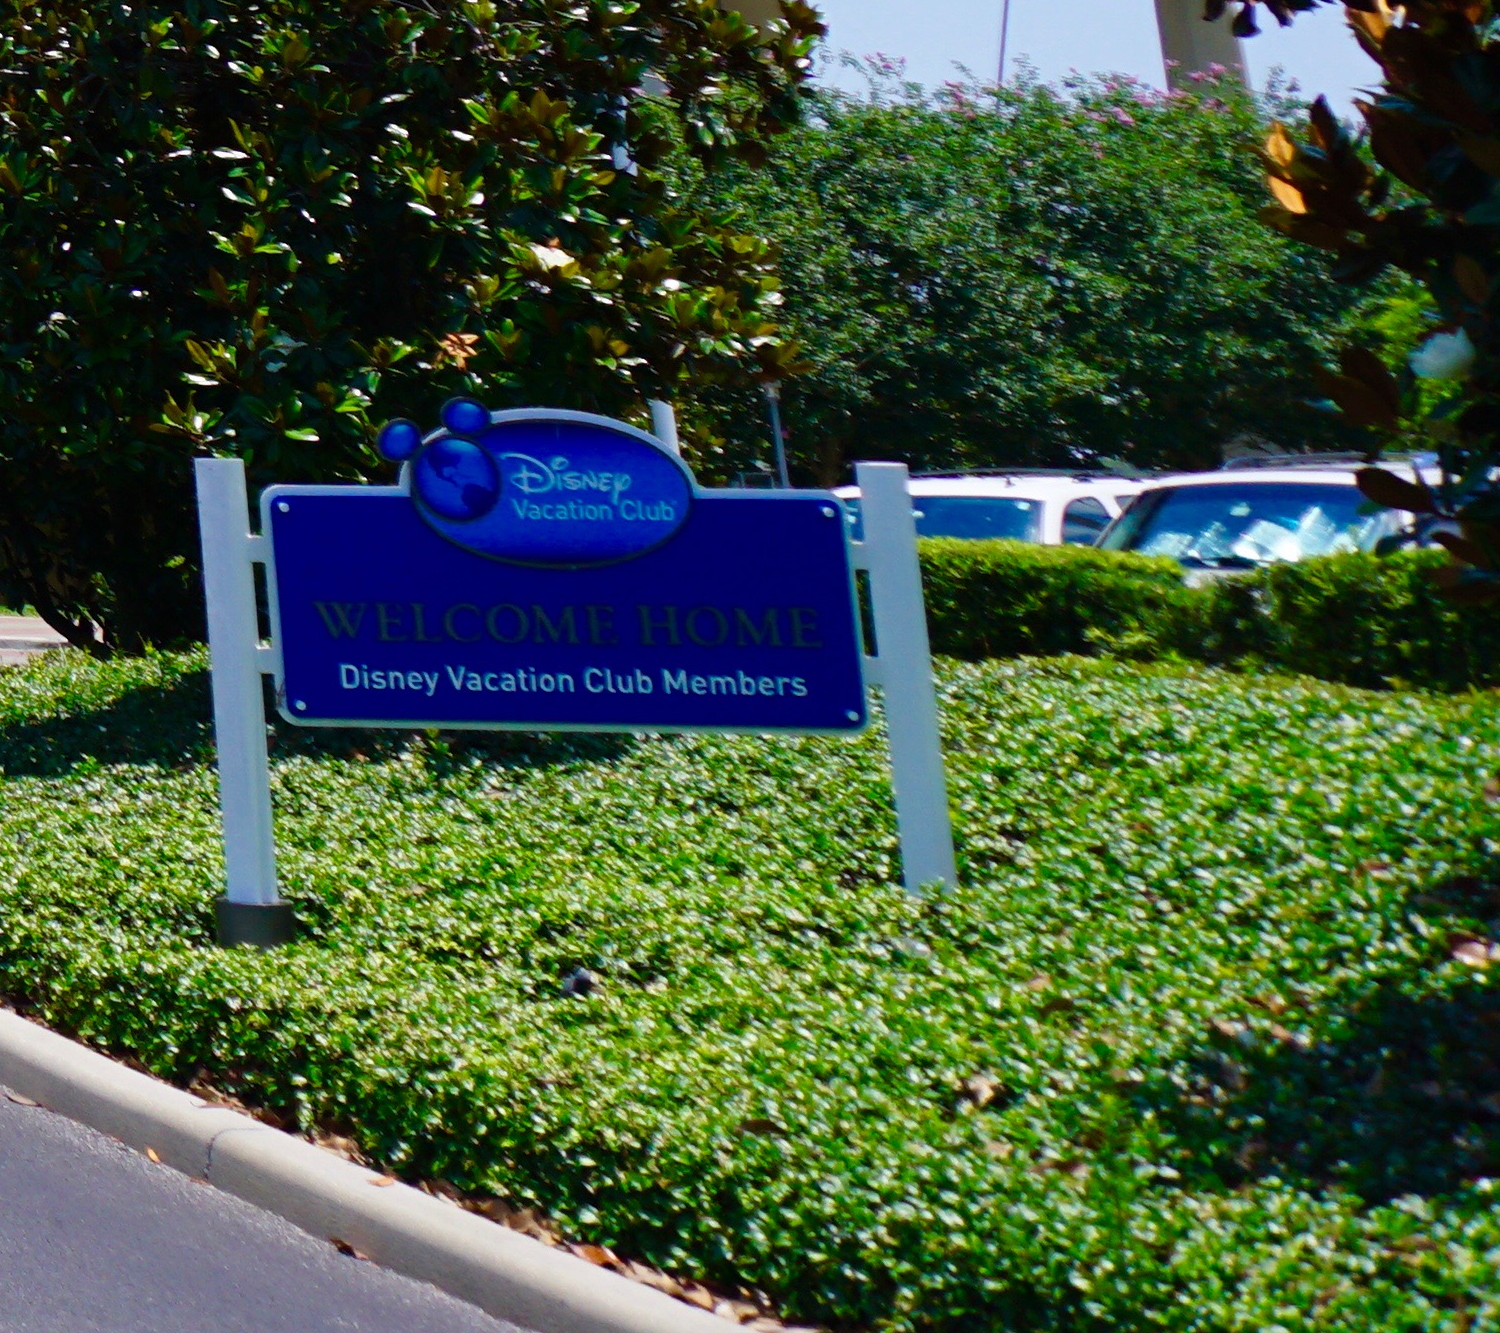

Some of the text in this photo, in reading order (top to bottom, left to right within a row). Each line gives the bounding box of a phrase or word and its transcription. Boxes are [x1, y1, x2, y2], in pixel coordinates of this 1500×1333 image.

[500, 452, 631, 505] Disney
[512, 499, 675, 521] Vacation Club
[314, 601, 823, 648] WELCOME HOME
[340, 663, 808, 697] Disney Vacation Club Members
